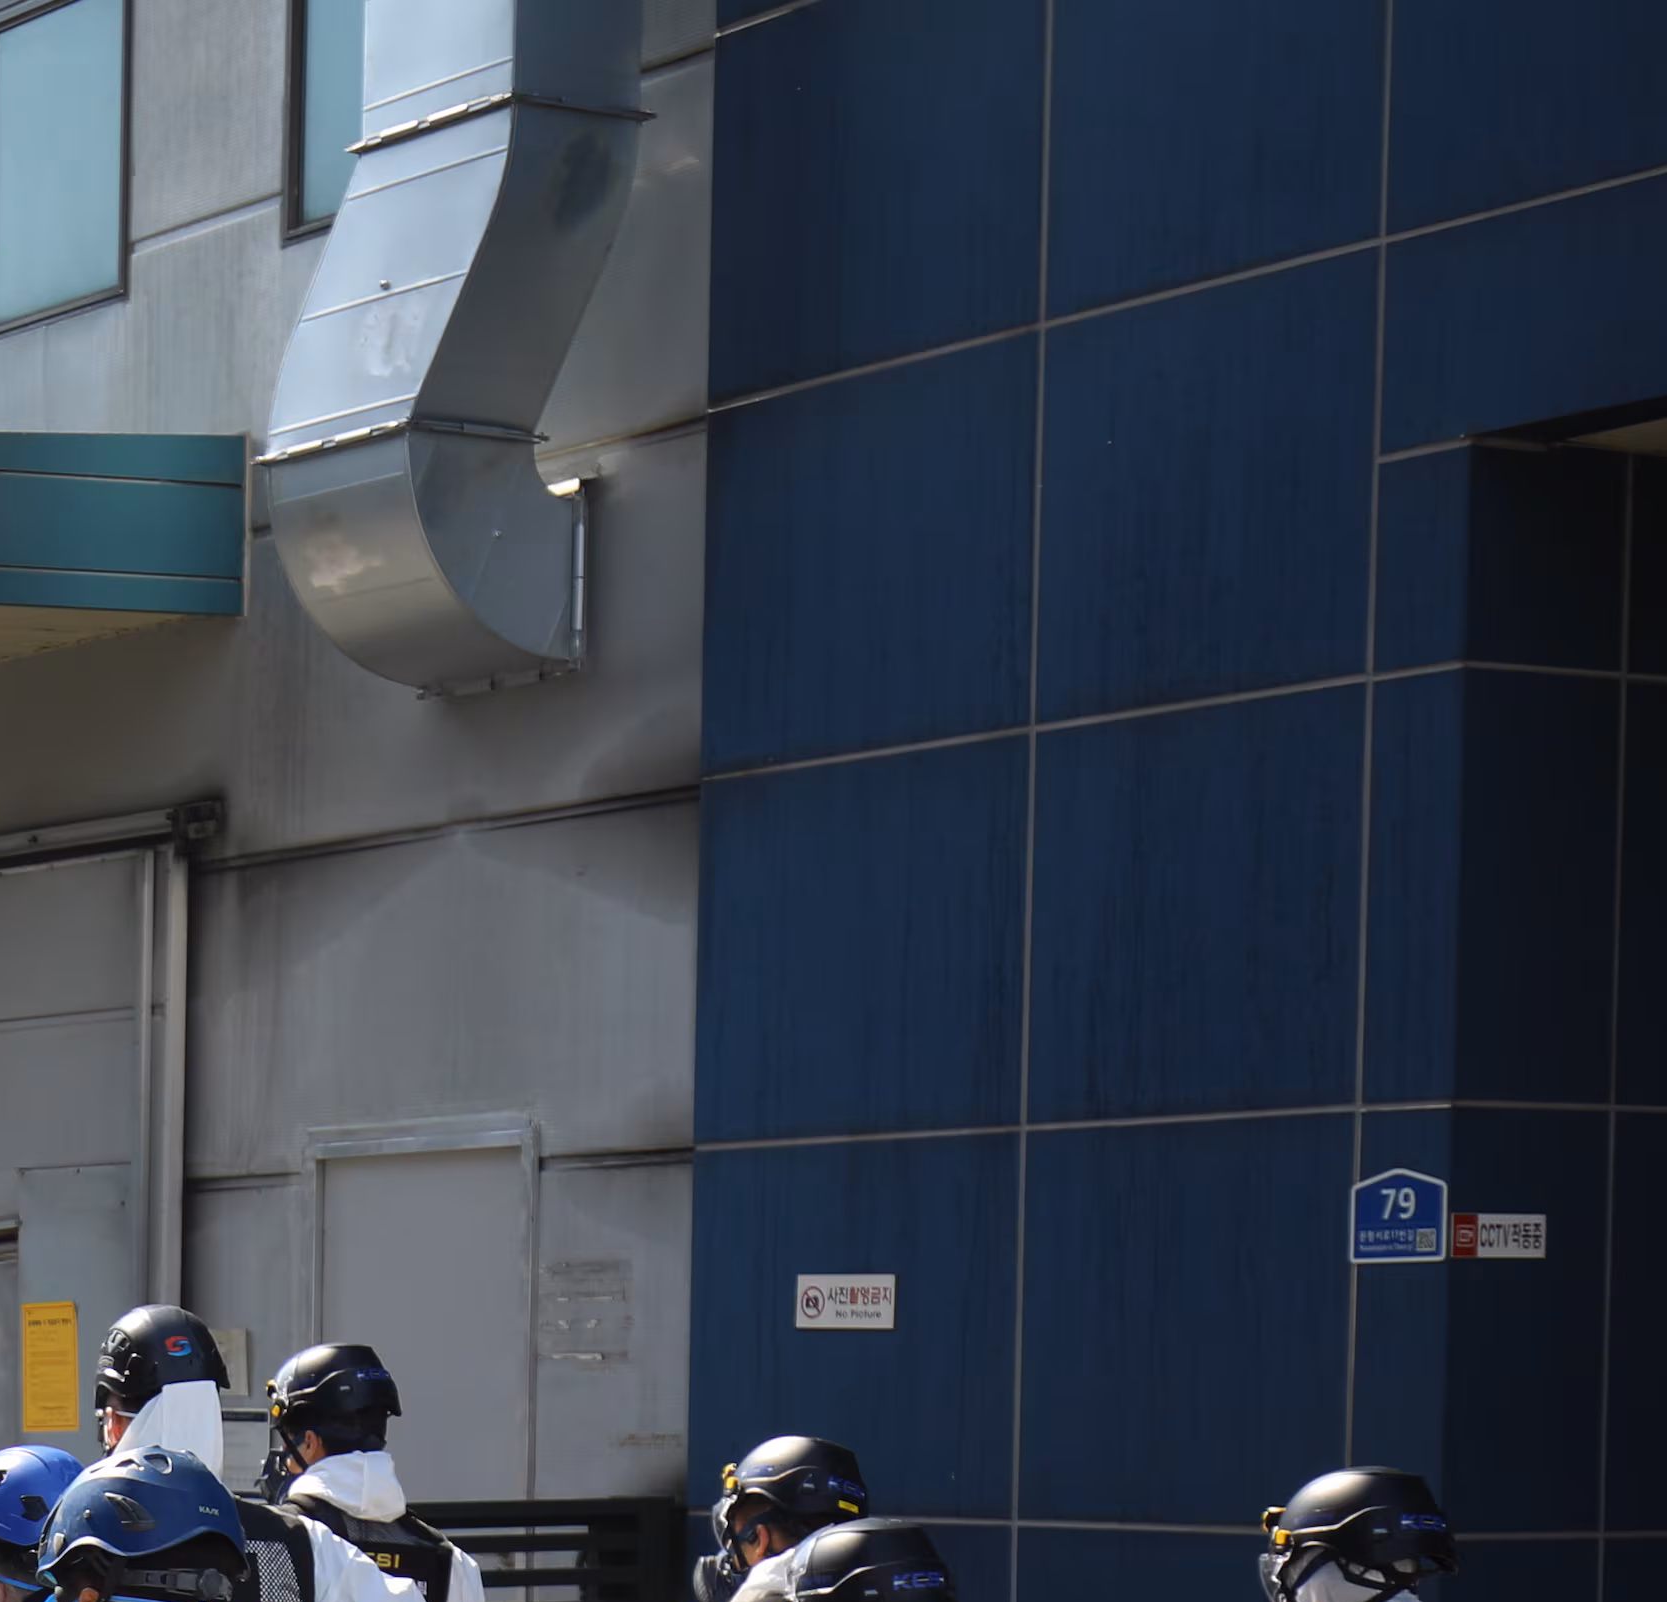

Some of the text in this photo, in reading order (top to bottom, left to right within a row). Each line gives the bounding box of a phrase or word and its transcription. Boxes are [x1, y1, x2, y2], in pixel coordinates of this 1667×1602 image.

[1380, 1187, 1416, 1220] 79
[1480, 1223, 1542, 1249] CCTV작동중
[828, 1286, 892, 1306] 사진촬영금지
[850, 1309, 882, 1319] Picture
